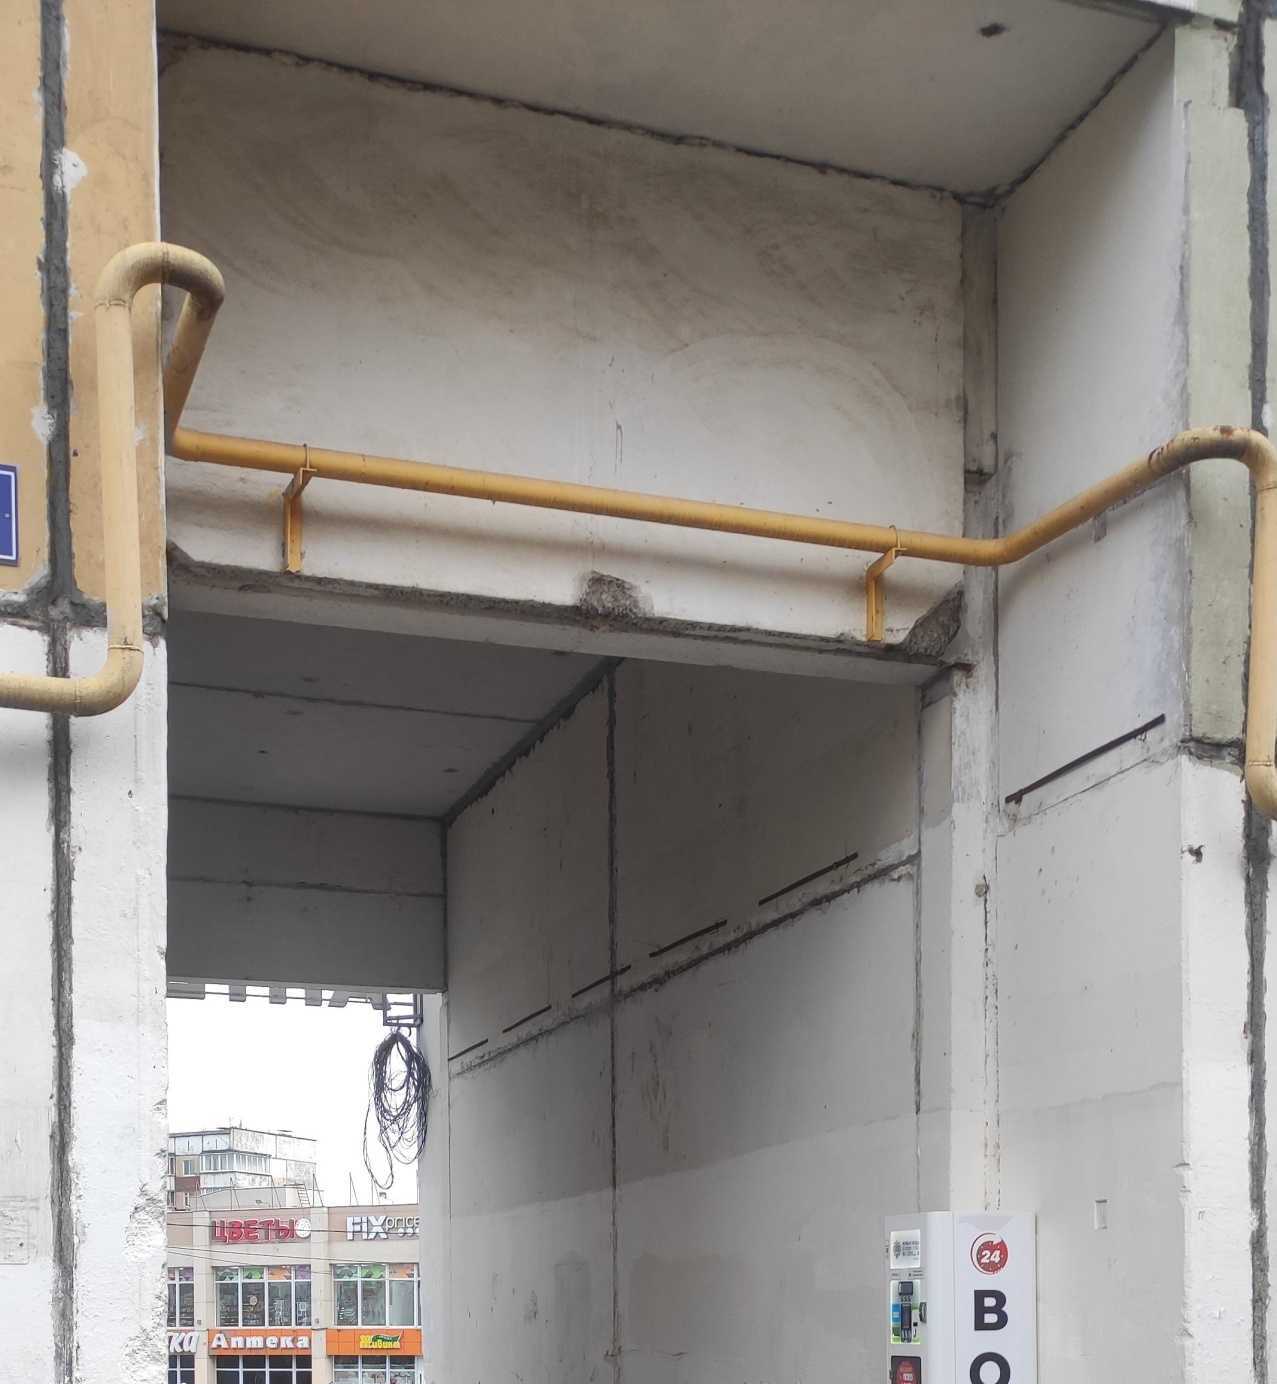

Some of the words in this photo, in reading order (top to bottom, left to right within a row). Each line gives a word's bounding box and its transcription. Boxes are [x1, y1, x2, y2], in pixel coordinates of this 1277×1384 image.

[210, 1218, 294, 1243] ЦВЕТЫ
[980, 1249, 1000, 1264] 24
[211, 1333, 310, 1349] Аптека
